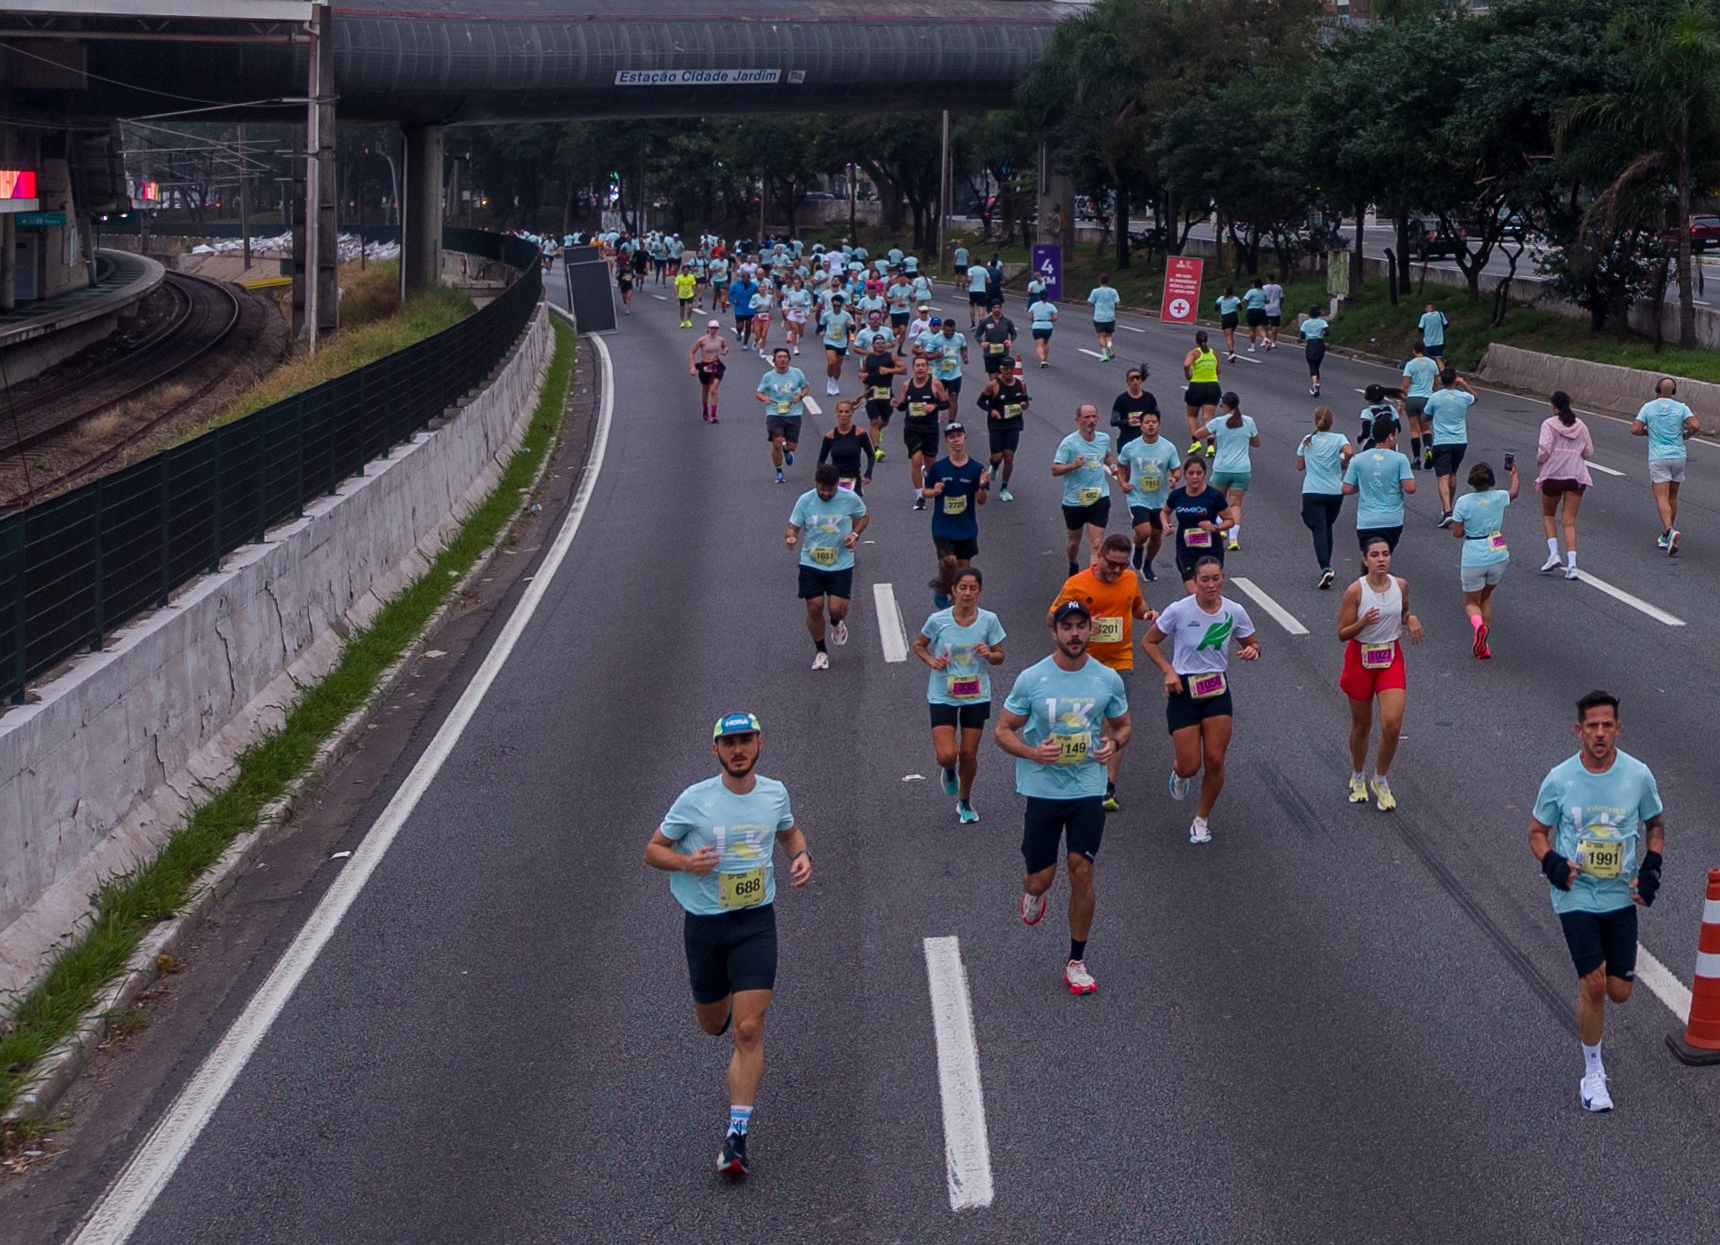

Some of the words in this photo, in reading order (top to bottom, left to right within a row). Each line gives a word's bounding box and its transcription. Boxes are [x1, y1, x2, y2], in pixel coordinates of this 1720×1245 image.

[619, 71, 677, 85] Estação
[681, 70, 729, 82] Cidade
[733, 69, 777, 82] Jardim
[1041, 258, 1054, 274] 4
[1589, 851, 1619, 866] 1991
[735, 877, 761, 896] 688
